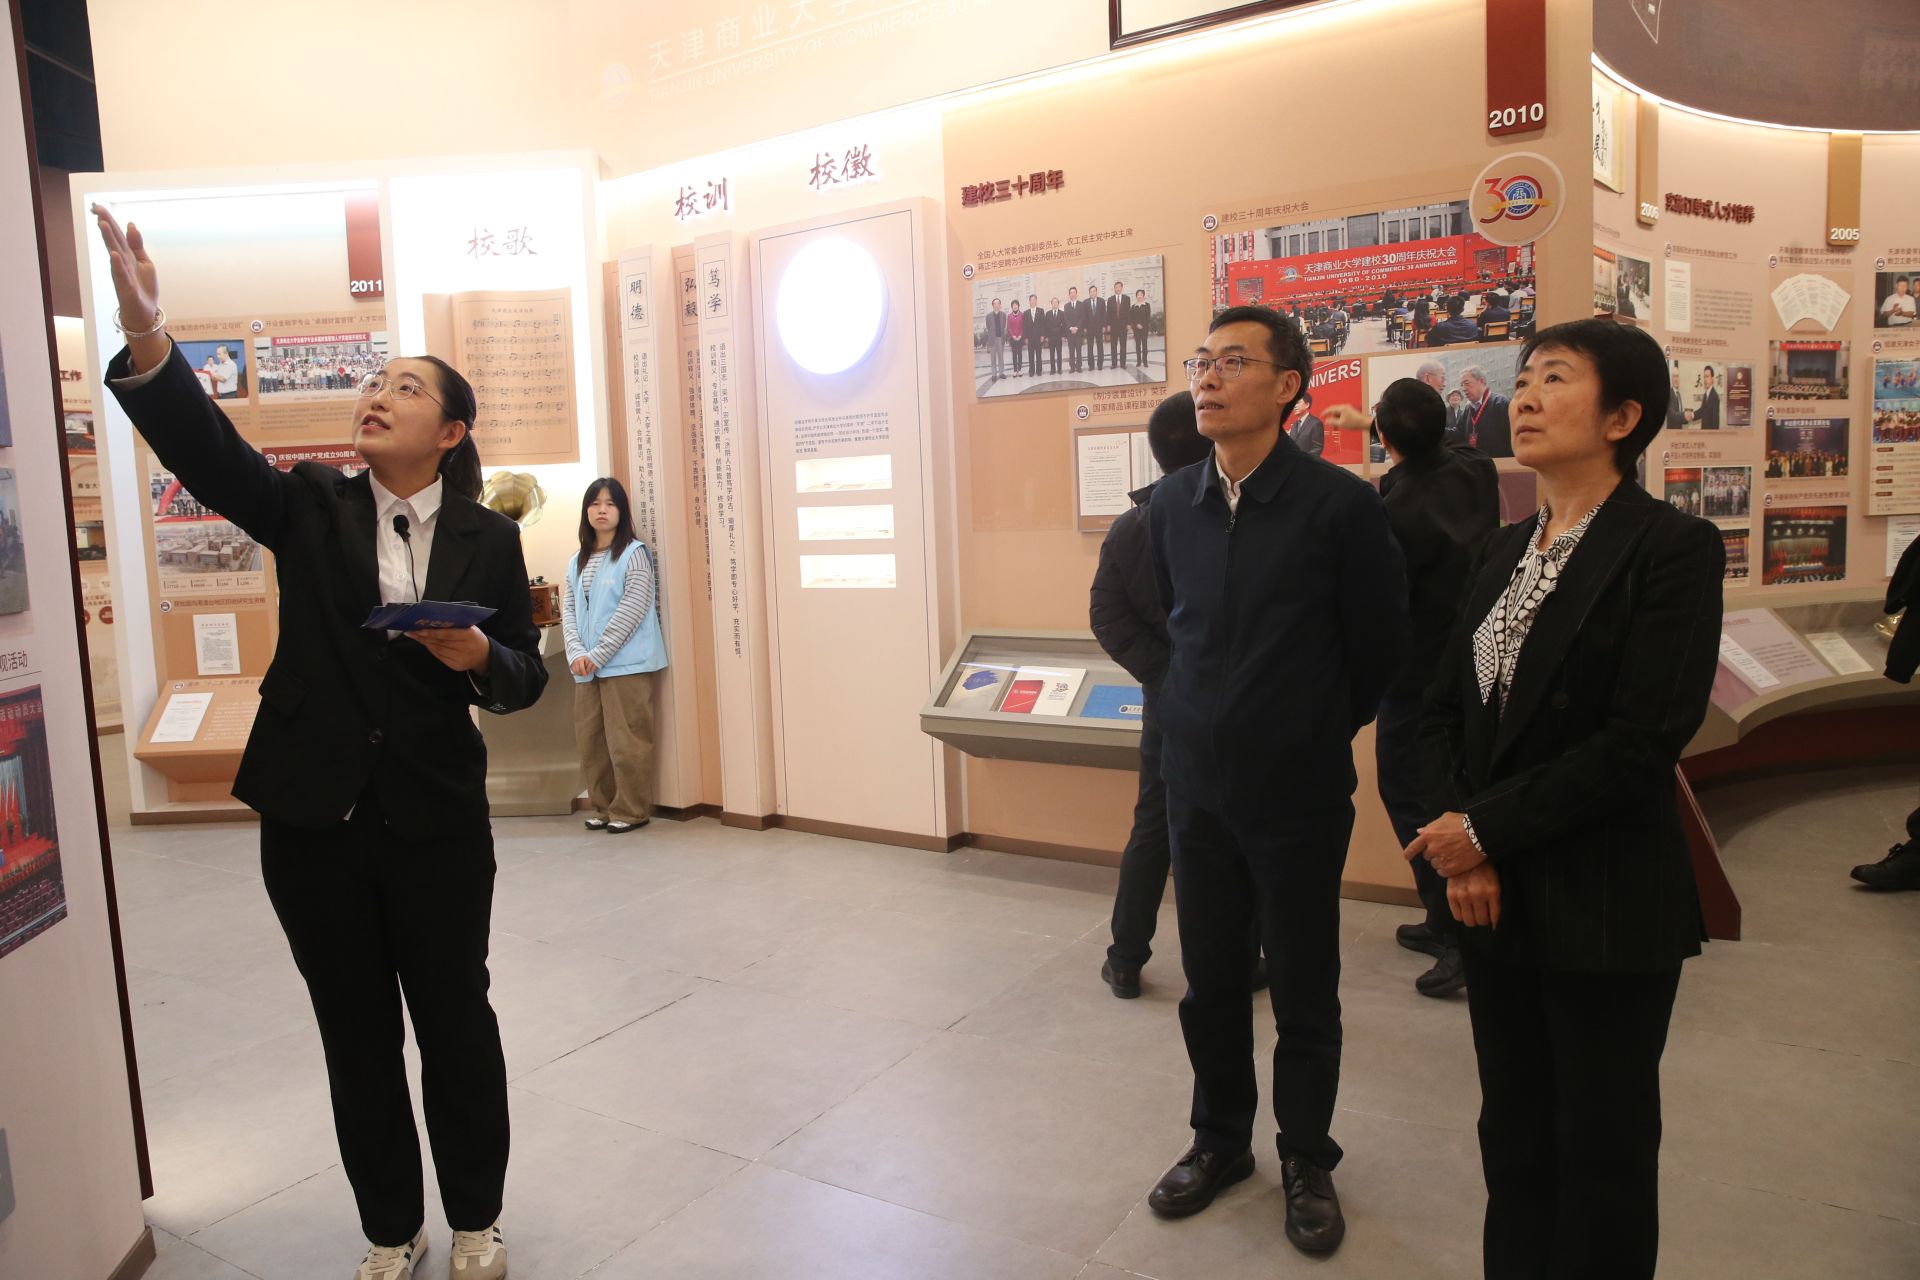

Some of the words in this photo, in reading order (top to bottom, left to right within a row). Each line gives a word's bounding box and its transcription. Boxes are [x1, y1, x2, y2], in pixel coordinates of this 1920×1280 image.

[706, 46, 799, 88] UNIVERSITY
[805, 37, 825, 57] OF
[1489, 103, 1544, 129] 2010
[809, 144, 875, 190] 校徽
[674, 177, 729, 221] 校训
[961, 170, 1064, 207] 建校三十周年
[1480, 175, 1543, 223] 30
[1220, 201, 1310, 223] 建校三十周年庆祝大会
[467, 226, 538, 259] 校歌
[1831, 228, 1860, 240] 2005
[978, 248, 1082, 272] 蒋正华受聘为学校经济研究所所长
[1304, 246, 1457, 274] 天津商业大学建校30周年庆祝大会
[1327, 271, 1360, 279] UNIVERSITY
[1371, 265, 1405, 274] COMMERCE
[1415, 259, 1457, 269] ANNIVERSARY
[350, 280, 383, 293] 2011
[629, 279, 644, 320] 明德
[684, 277, 699, 317] 弘毅
[707, 267, 722, 312] 笃学
[278, 451, 357, 461] 庆祝中国共产党成立90周年
